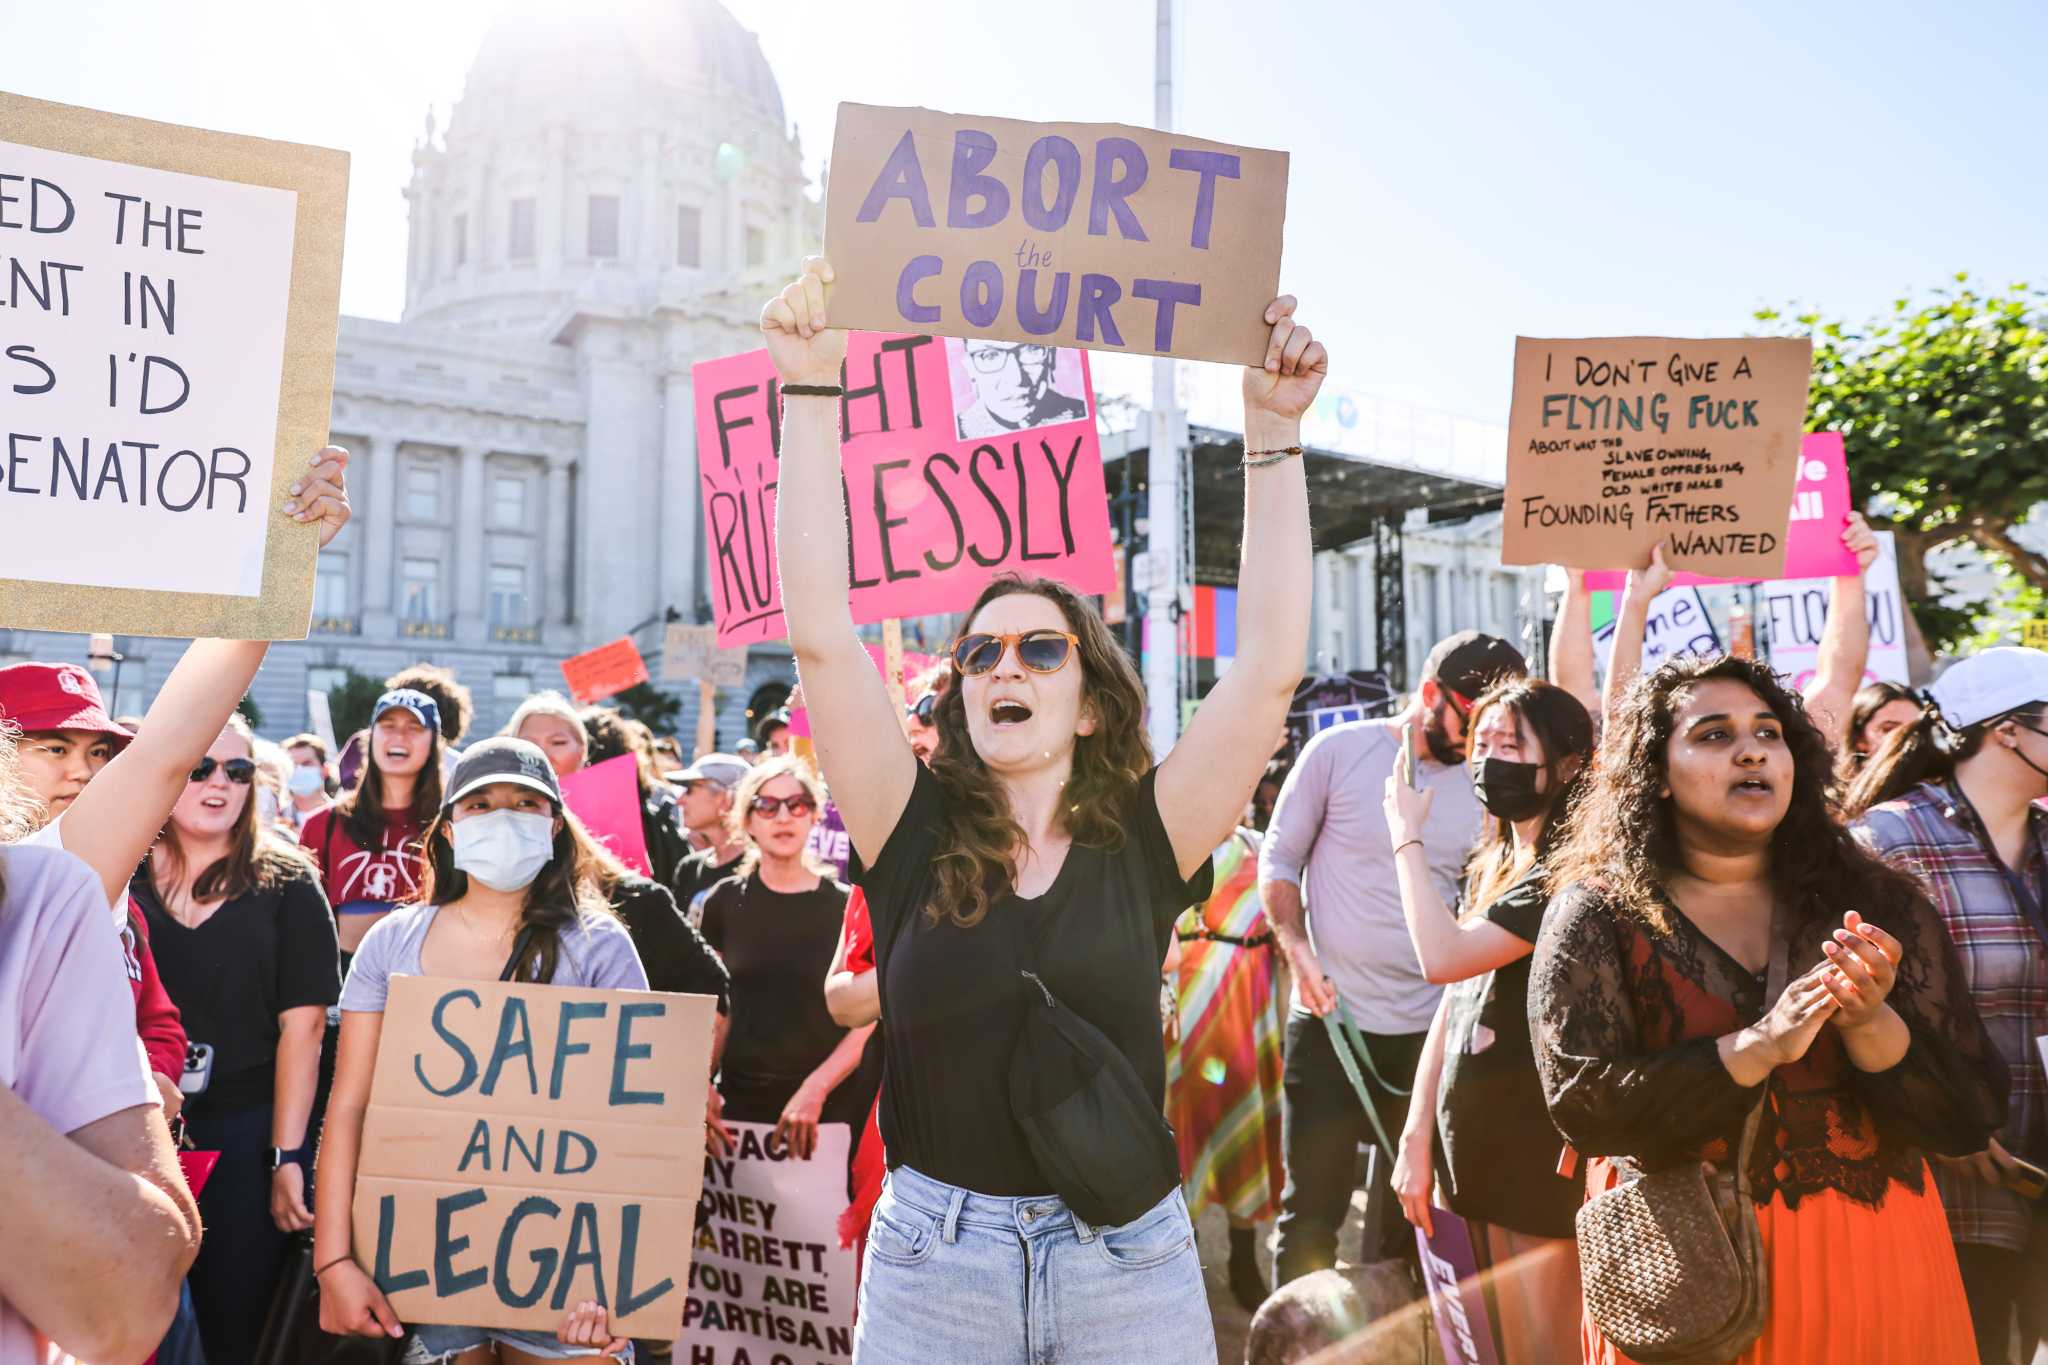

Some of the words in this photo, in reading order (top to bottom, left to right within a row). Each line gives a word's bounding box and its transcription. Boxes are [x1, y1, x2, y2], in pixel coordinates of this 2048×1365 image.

[856, 129, 1240, 250] ABORT
[105, 192, 204, 254] THE
[1014, 239, 1053, 268] the
[0, 253, 84, 316] NT
[123, 272, 175, 335] IN
[896, 255, 1201, 352] COURT
[6, 346, 56, 394] S
[109, 352, 190, 414] I'D
[1545, 353, 1552, 381] I
[1575, 357, 1657, 386] DON'T
[1667, 354, 1719, 386] GIVE
[1733, 356, 1753, 380] A
[714, 336, 933, 468] FIHT
[1542, 394, 1668, 433] FLYING
[1688, 395, 1760, 429] FUCK
[0, 432, 250, 513] ENATOR
[1528, 438, 1570, 455] ABOUT
[1574, 439, 1597, 451] WHAT
[1600, 437, 1623, 448] THE
[1602, 467, 1655, 481] FEMALE
[1661, 462, 1744, 475] OPPRESSING
[1603, 448, 1654, 465] SLAVE
[1522, 495, 1634, 530] FOUNDING
[1645, 495, 1740, 523] FATHERS
[1602, 485, 1631, 498] OLD
[1641, 482, 1682, 494] WHITE
[1687, 479, 1722, 490] MALE
[709, 436, 1083, 614] RULESSLY
[1670, 530, 1776, 556] WANTED
[1769, 590, 1828, 644] FUC
[414, 988, 666, 1106] SAFE
[457, 1118, 598, 1175] AND
[372, 1188, 674, 1318] LEGAL
[692, 1224, 828, 1278] ARRETT.
[762, 1275, 829, 1314] ARE
